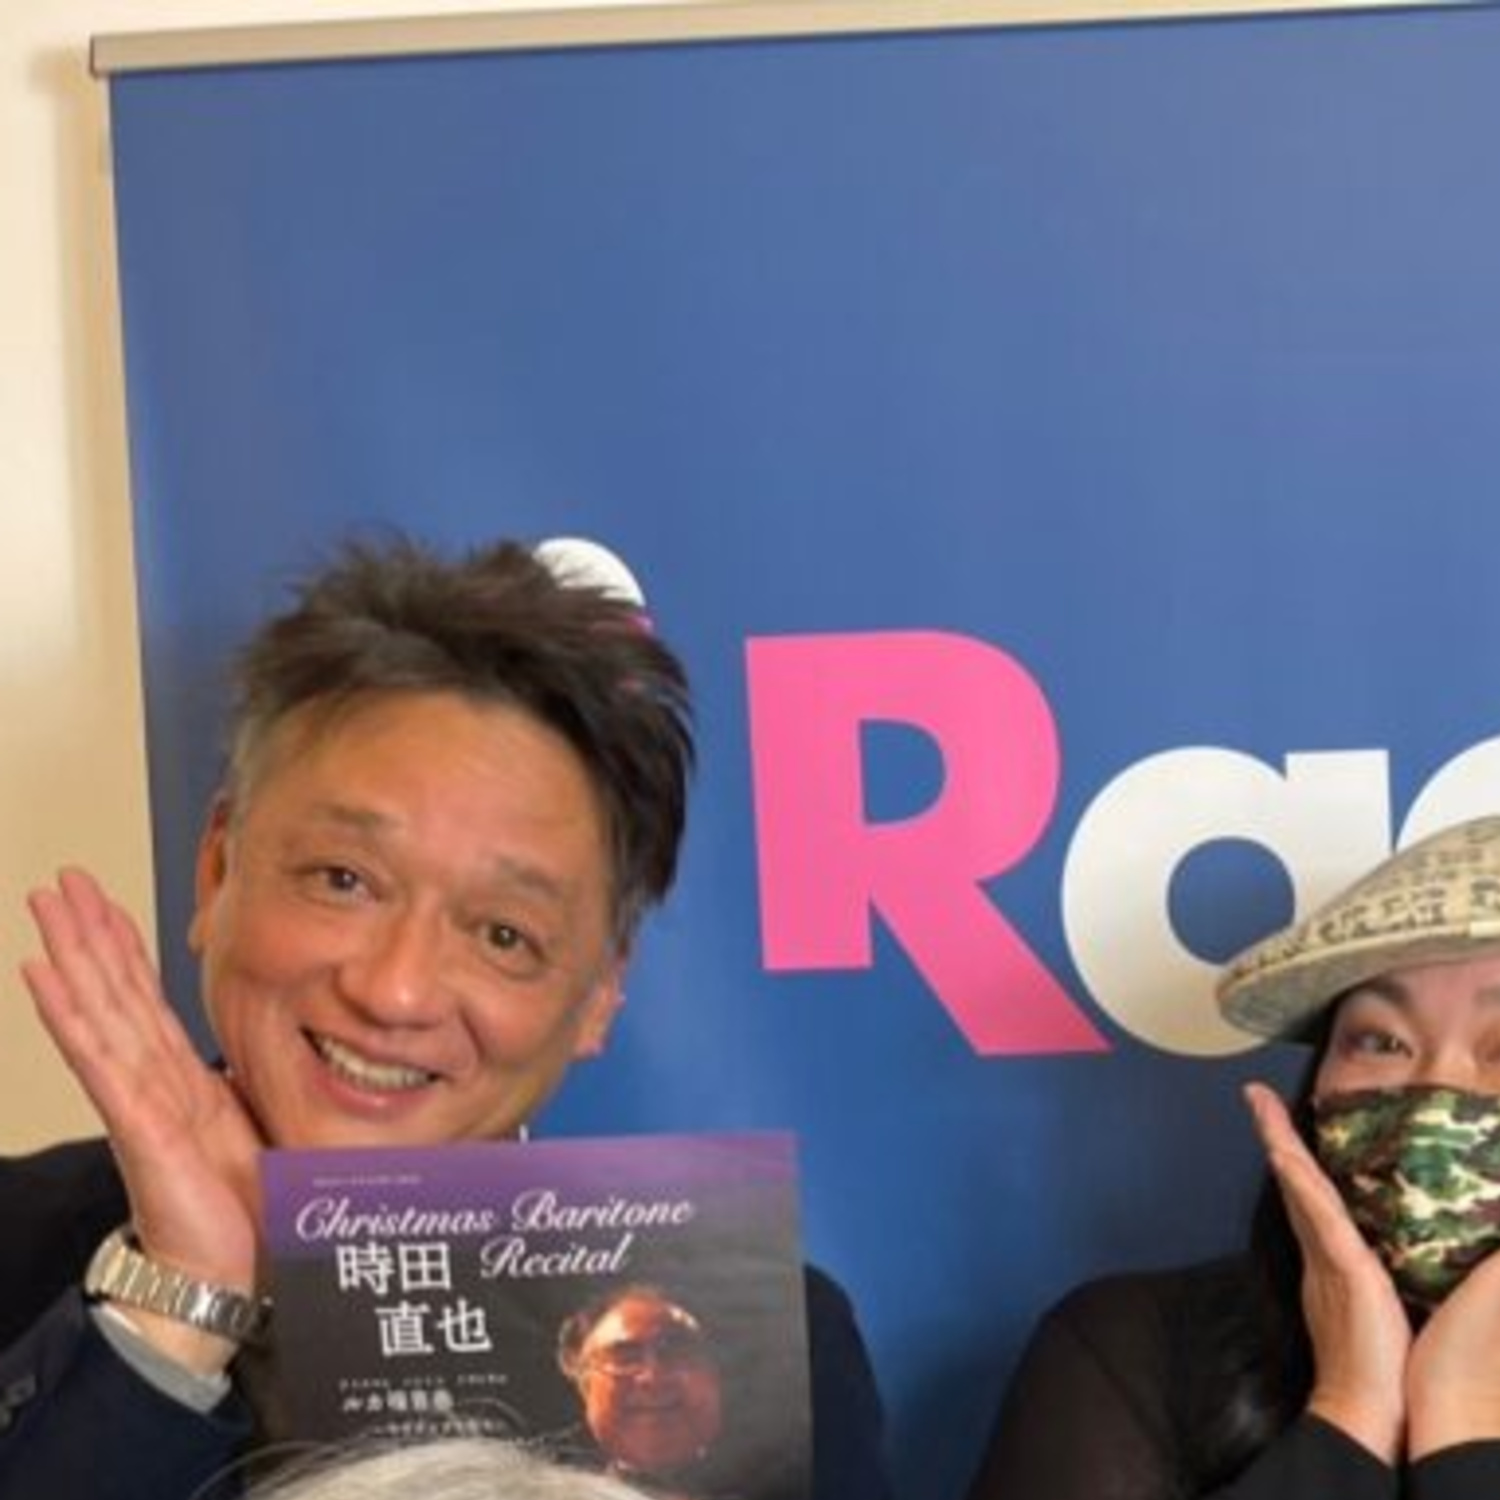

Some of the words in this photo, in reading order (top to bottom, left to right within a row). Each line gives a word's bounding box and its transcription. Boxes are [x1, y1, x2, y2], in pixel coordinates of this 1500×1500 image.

[295, 1198, 496, 1243] Christmas
[511, 1189, 695, 1233] Baritone
[336, 1241, 453, 1296] 時田
[479, 1232, 635, 1281] Recital
[375, 1297, 493, 1357] 直也
